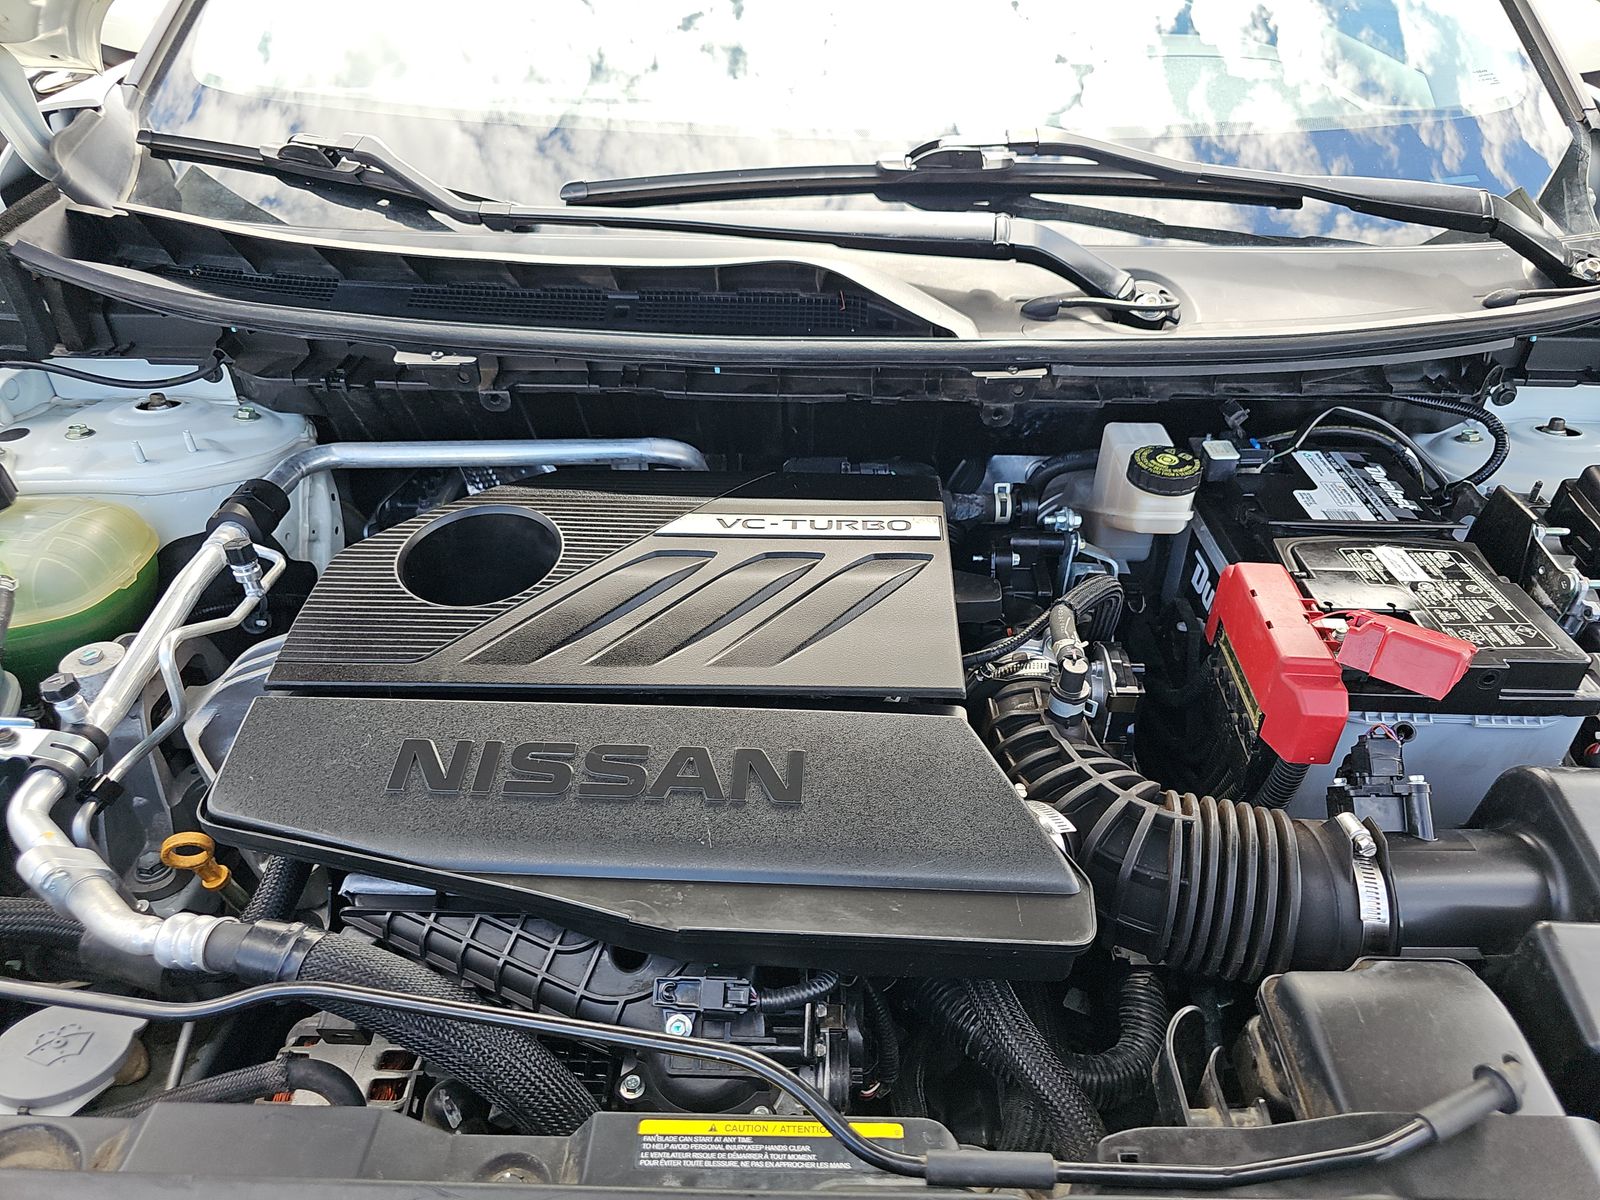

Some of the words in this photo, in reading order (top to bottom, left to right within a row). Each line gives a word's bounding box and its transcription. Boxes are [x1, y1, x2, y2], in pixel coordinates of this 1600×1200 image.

[1364, 466, 1419, 510] Duralast
[716, 518, 912, 531] VC-TURBO
[1191, 550, 1215, 614] Du
[385, 737, 806, 803] NISSAN
[724, 1123, 769, 1133] CAUTION
[779, 1125, 827, 1134] ATTENTIO
[690, 1143, 725, 1151] PERSONAL
[765, 1144, 788, 1152] HANDS
[691, 1152, 717, 1160] RISQUE
[717, 1152, 727, 1160] DE
[727, 1151, 765, 1160] DÉMARRER
[769, 1153, 787, 1161] TOUT
[640, 1159, 660, 1167] POUR
[659, 1158, 682, 1167] ÉVITER
[682, 1160, 704, 1168] TOUTE
[764, 1161, 775, 1169] EN
[774, 1161, 816, 1169] APPROCHER
